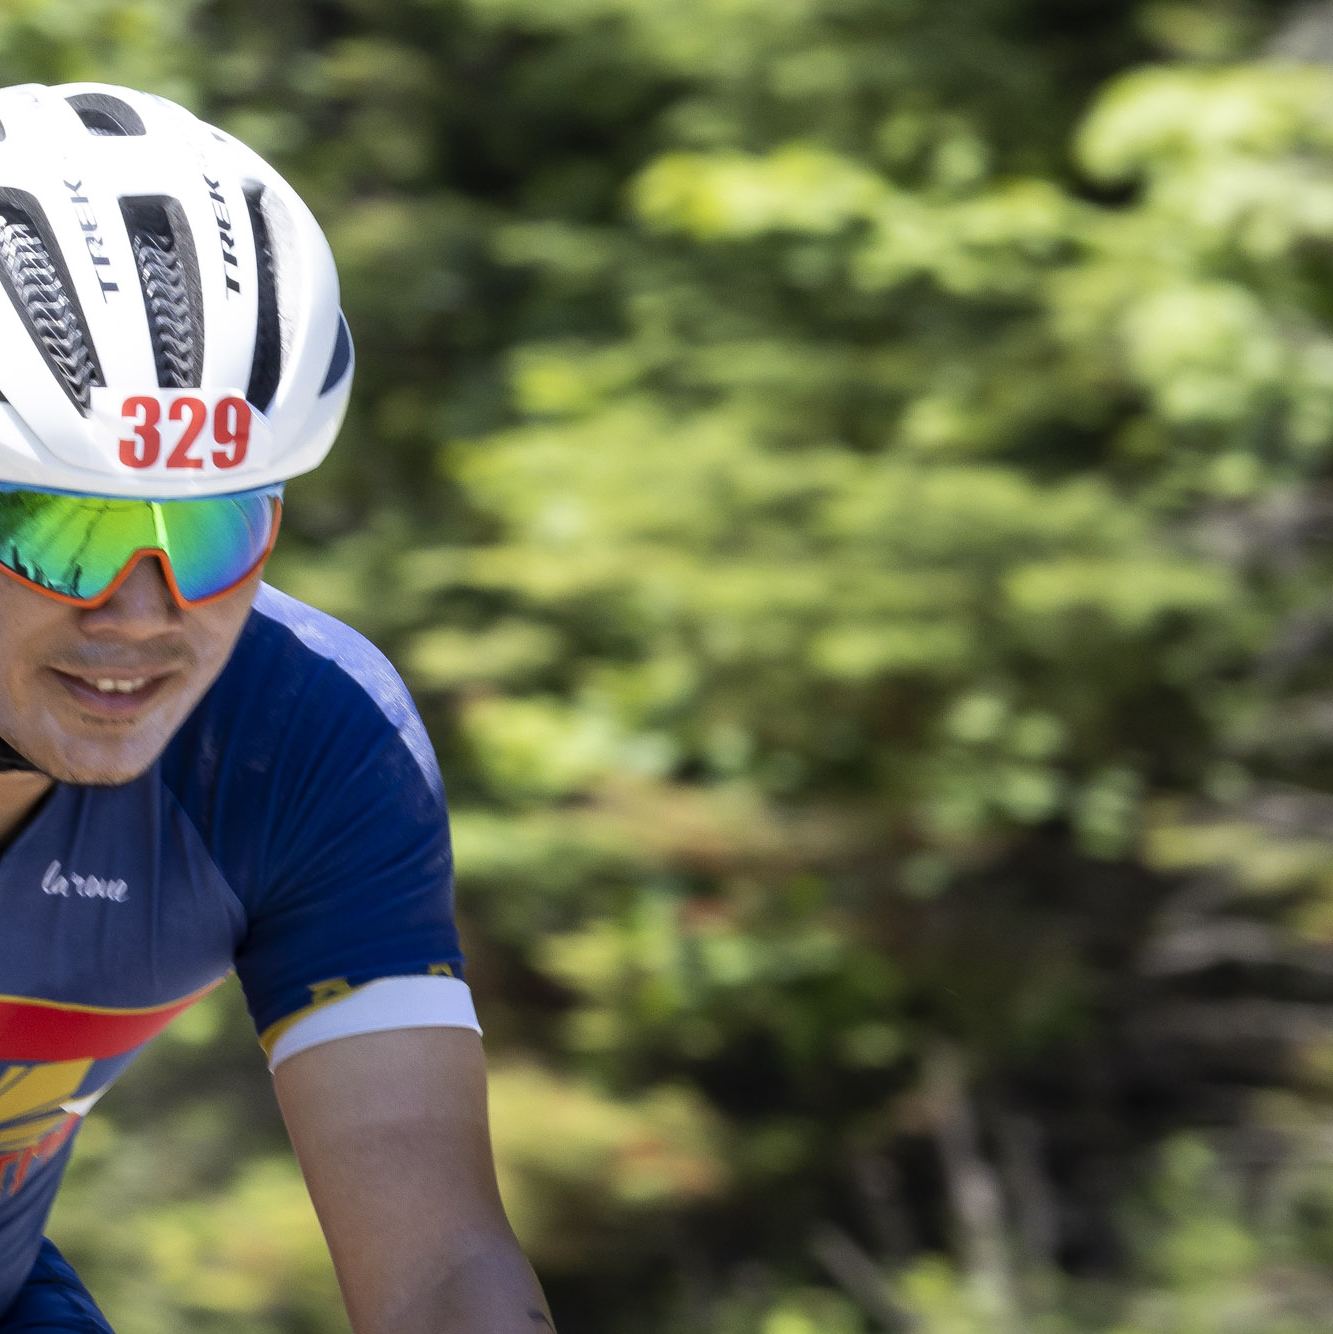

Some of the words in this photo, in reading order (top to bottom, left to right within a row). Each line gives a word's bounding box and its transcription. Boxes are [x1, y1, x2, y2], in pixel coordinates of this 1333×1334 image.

[63, 179, 119, 304] TREK
[202, 173, 241, 300] TREK
[118, 396, 252, 469] 329
